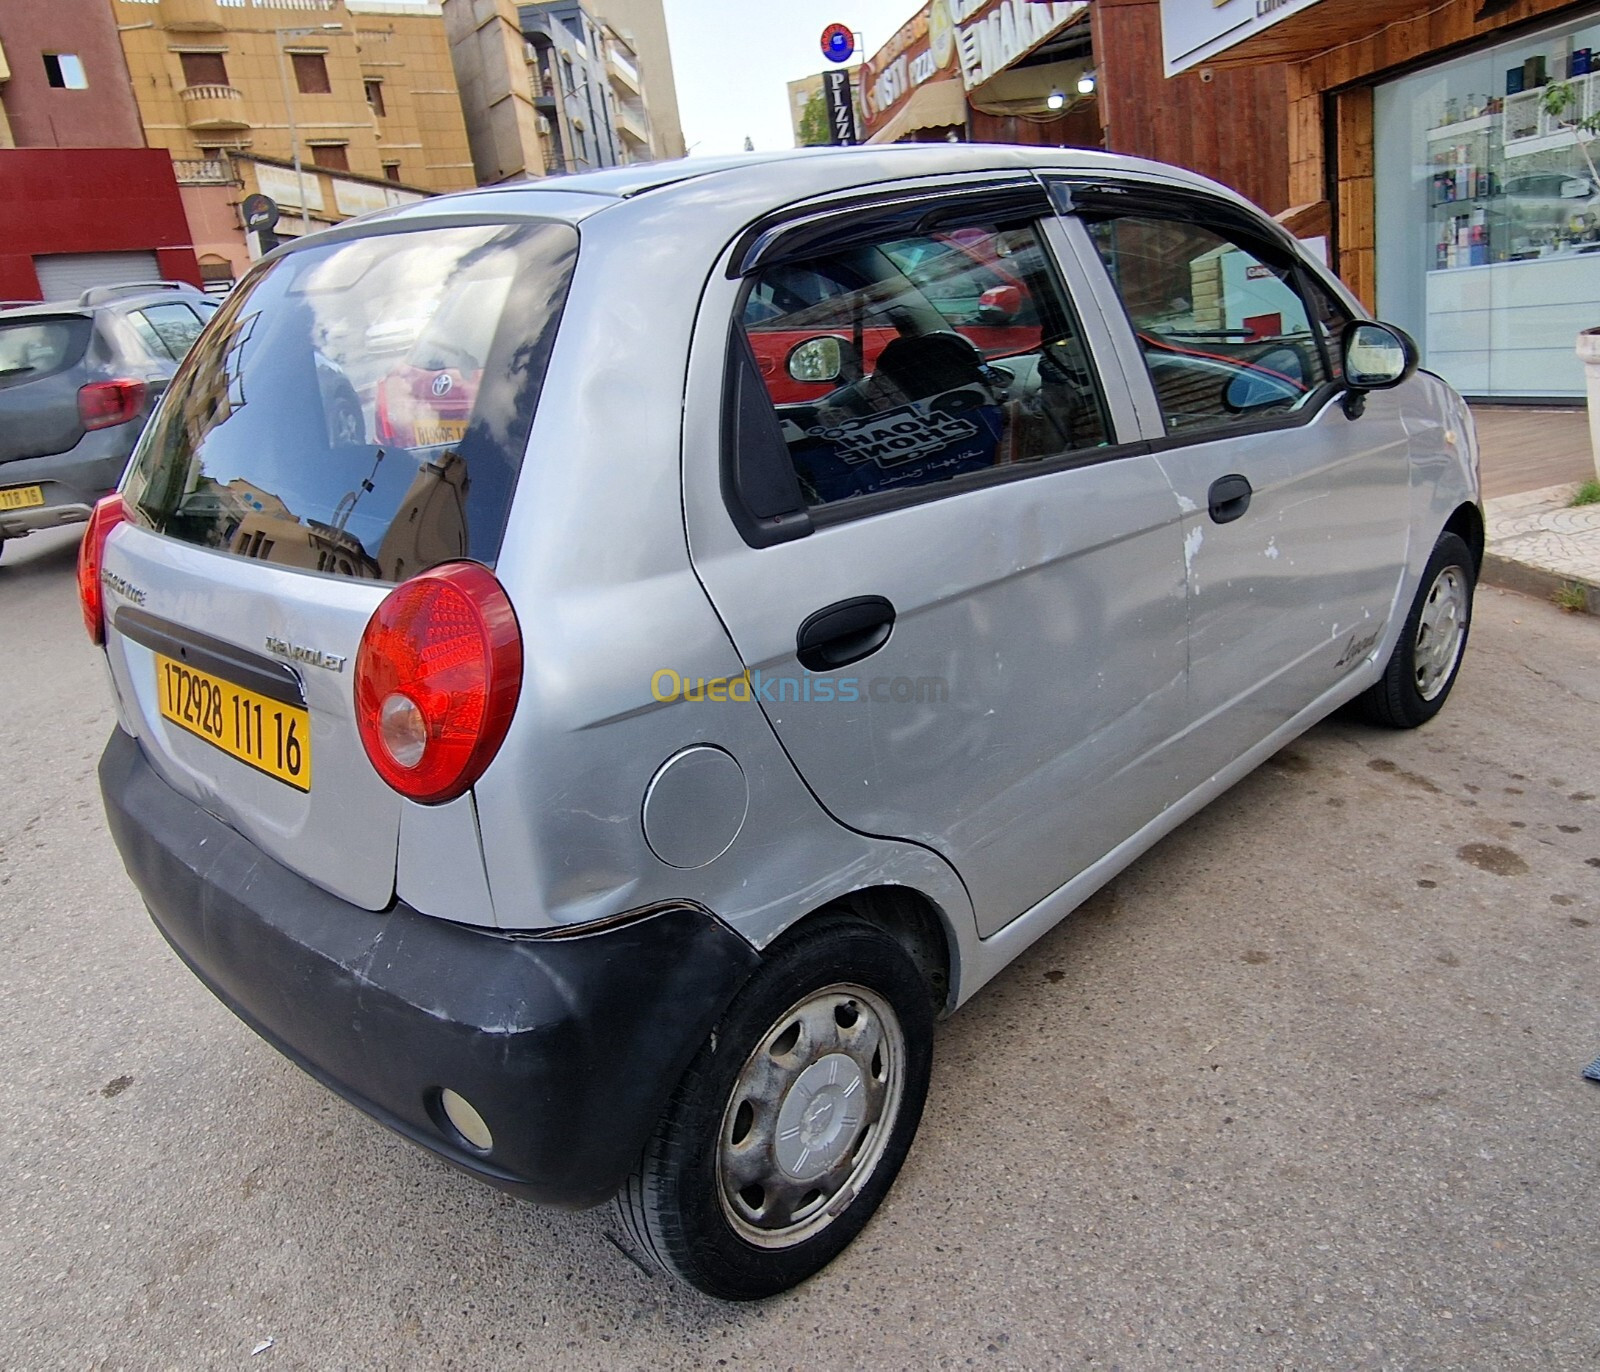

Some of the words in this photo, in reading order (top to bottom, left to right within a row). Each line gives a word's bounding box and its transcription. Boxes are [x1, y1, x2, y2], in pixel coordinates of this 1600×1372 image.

[165, 662, 223, 739] 172928
[232, 695, 262, 761] 111
[273, 712, 301, 776] 16
